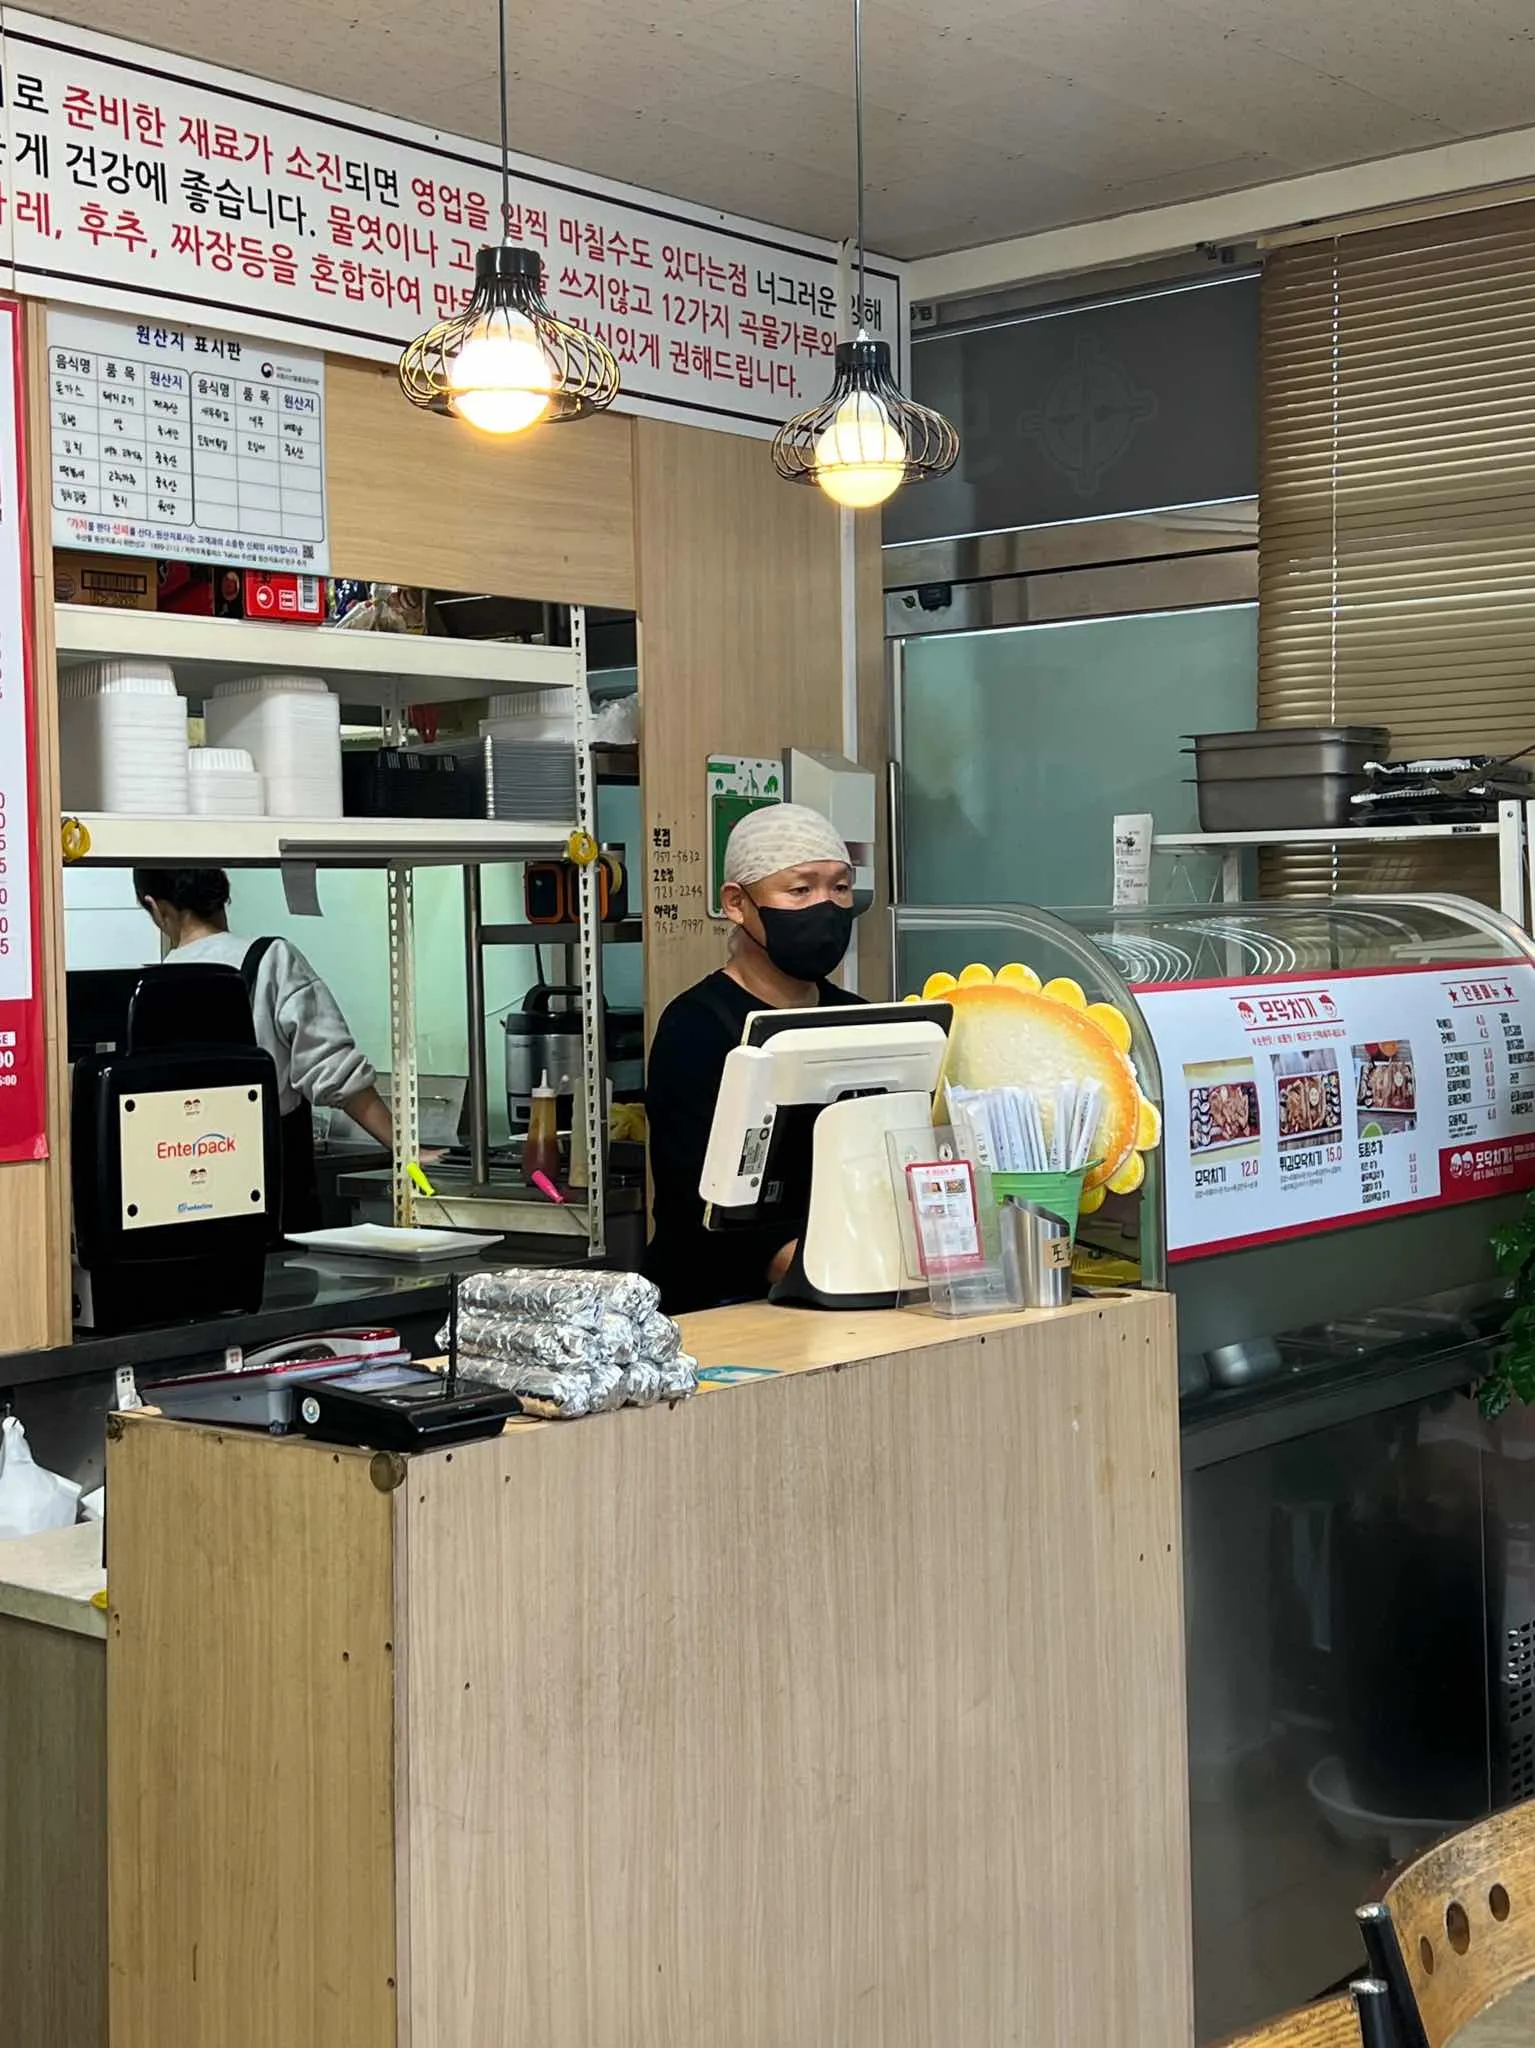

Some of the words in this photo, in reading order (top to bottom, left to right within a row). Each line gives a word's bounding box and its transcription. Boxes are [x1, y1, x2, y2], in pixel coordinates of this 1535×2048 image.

[63, 85, 166, 148] 준비한
[179, 115, 274, 176] 재료가
[286, 146, 400, 208] 소진되면
[411, 177, 490, 230] 영업을
[500, 202, 547, 248] 일찍
[559, 218, 654, 269] 마칠수도
[662, 245, 748, 298] 있다는점
[756, 270, 838, 320] 너그러운
[66, 143, 168, 204] 건강에
[180, 168, 317, 238] 좋습니다.
[327, 205, 439, 268] 물엿이나
[558, 266, 653, 317] 쓰지않고
[662, 293, 731, 334] 12가지
[738, 310, 838, 358] 곡물가루와
[78, 203, 158, 259] 후추,
[171, 223, 299, 287] 짜장등을
[310, 253, 422, 315] 혼합하여
[669, 340, 801, 399] 권해드립니다.
[137, 325, 184, 351] 원산지
[194, 335, 241, 361] 표시판
[56, 354, 90, 373] 음식명
[150, 370, 182, 390] 원산지
[198, 379, 229, 398] 음식명
[284, 394, 314, 412] 원산지
[1258, 997, 1318, 1022] 모닥치기
[156, 1137, 237, 1160] Enterpack
[1280, 1150, 1322, 1172] 튀김모닥치기
[1326, 1146, 1342, 1162] 15.0
[1358, 1140, 1383, 1158] 토핑추가
[1195, 1166, 1226, 1187] 모닥치기
[1241, 1159, 1259, 1177] 12.0
